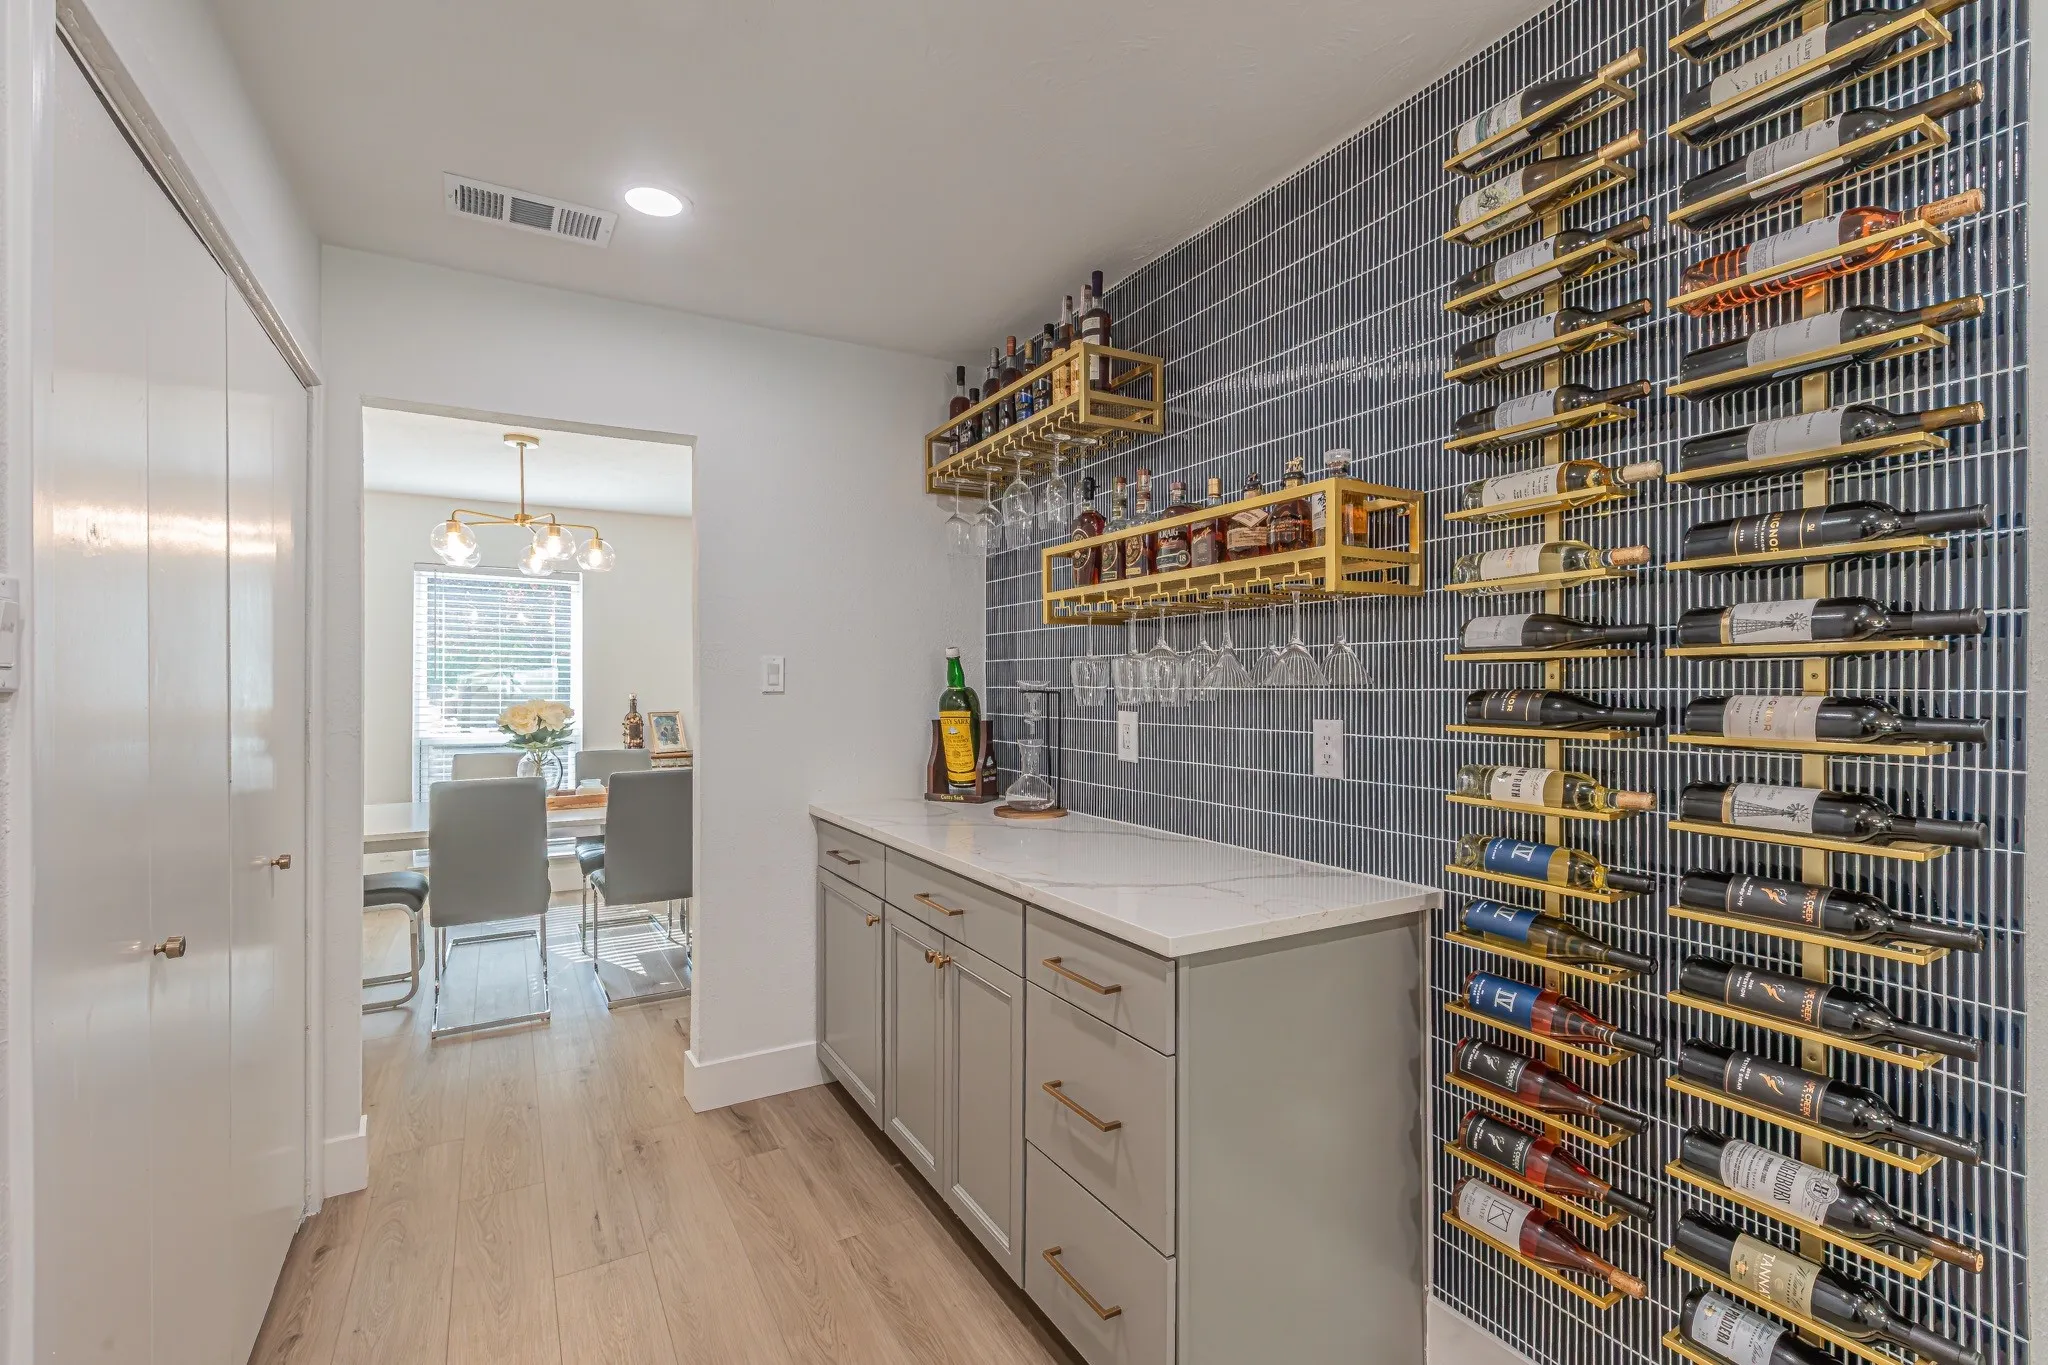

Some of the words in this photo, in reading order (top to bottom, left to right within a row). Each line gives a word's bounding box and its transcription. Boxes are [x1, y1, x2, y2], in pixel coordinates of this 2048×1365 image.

[1511, 778, 1523, 798] RUTH
[1802, 998, 1814, 1023] CREEK
[1801, 1092, 1813, 1117] CREEK
[1477, 1193, 1492, 1221] ESTATE
[1717, 1307, 1740, 1345] PRADERA
